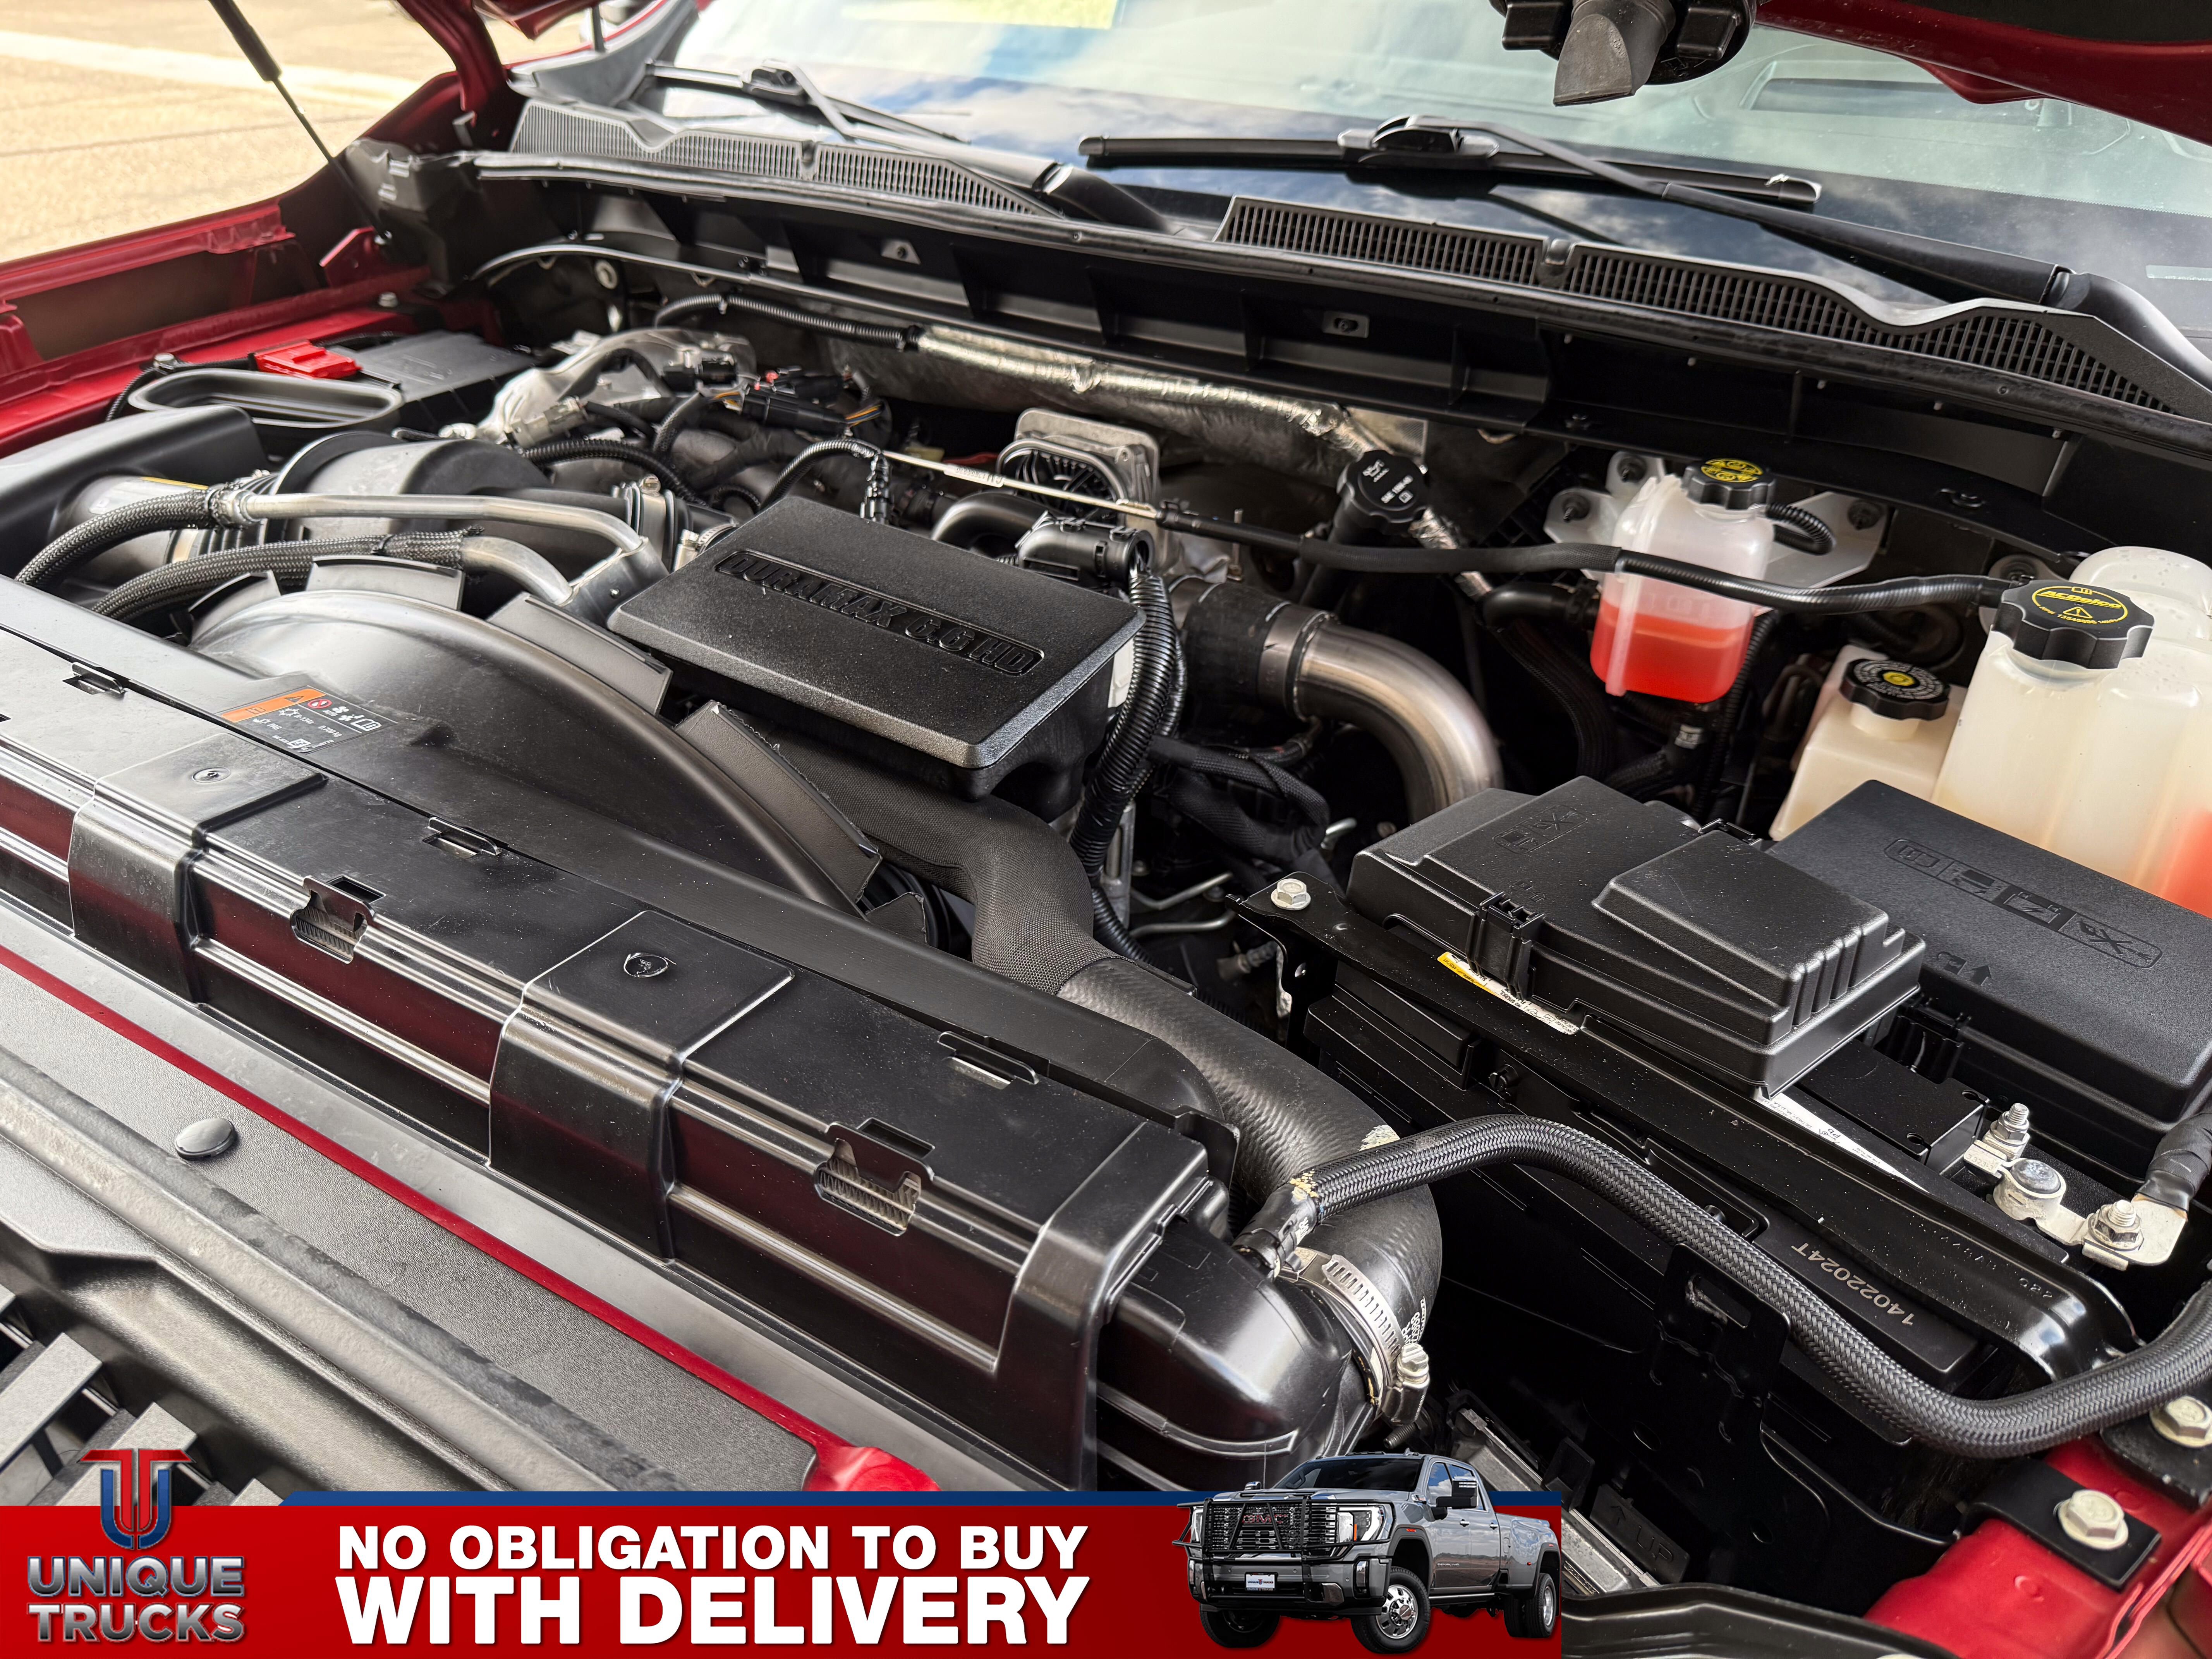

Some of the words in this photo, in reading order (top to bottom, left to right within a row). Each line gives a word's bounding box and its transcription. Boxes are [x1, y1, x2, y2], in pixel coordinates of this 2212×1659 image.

[720, 554, 910, 627] DURAMAX
[904, 610, 974, 654] 6.6
[970, 633, 1037, 674] HD
[2040, 591, 2122, 608] ACDelco
[1827, 1128, 1841, 1139] Pb
[1791, 1242, 1915, 1326] 14022024T
[1637, 1525, 1674, 1561] UP
